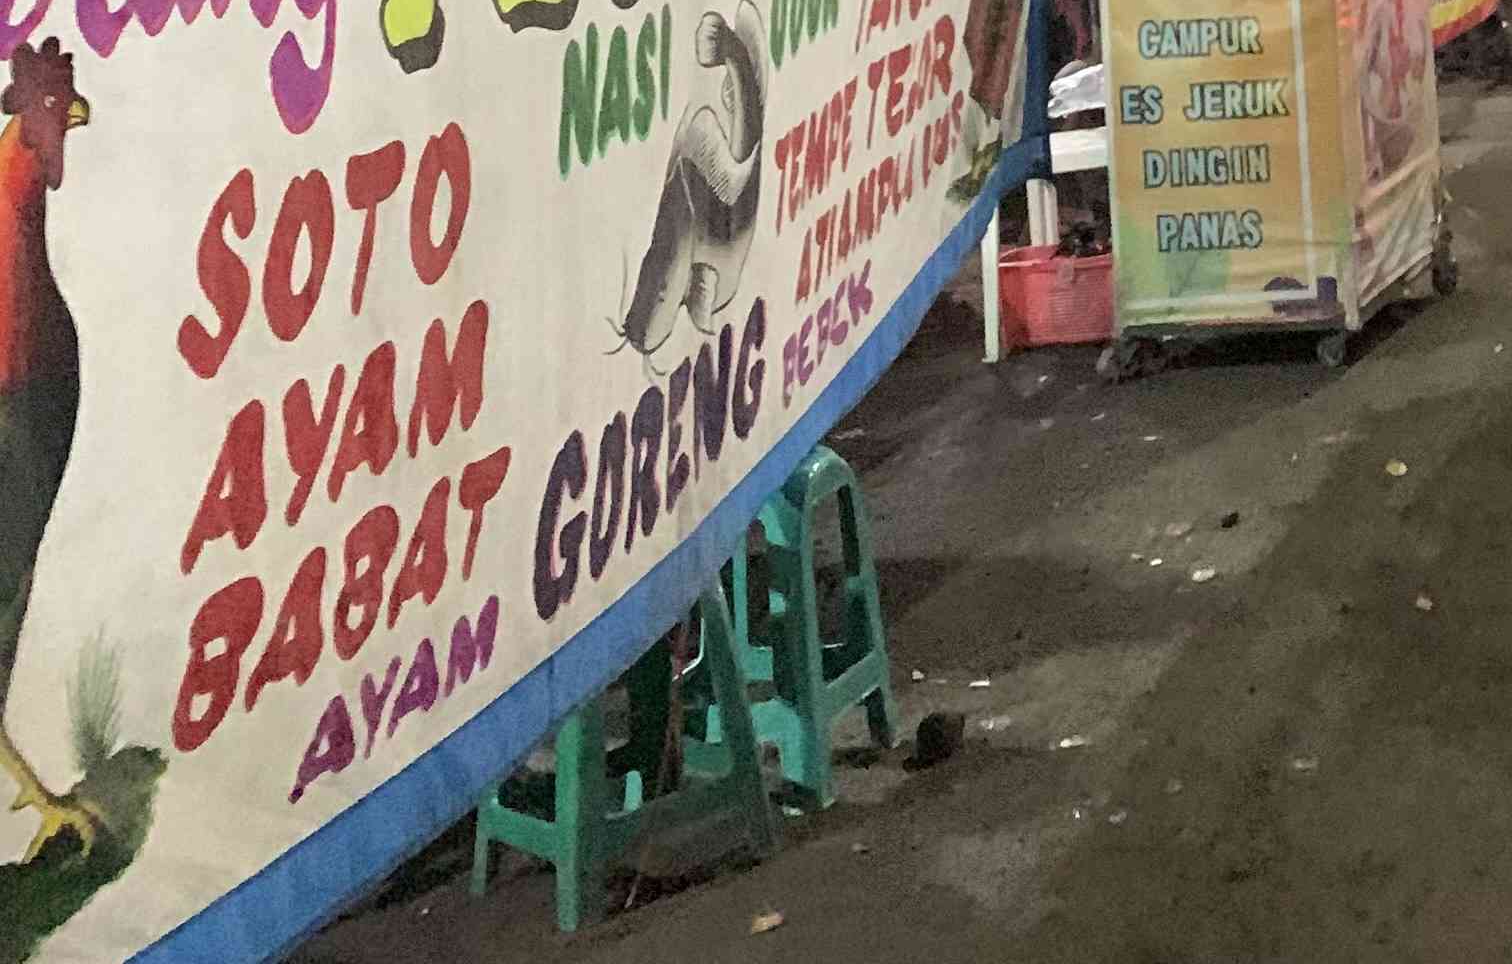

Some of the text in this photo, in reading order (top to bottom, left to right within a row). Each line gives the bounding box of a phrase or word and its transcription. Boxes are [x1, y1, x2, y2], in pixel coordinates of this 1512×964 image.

[557, 3, 672, 181] NASI
[1120, 78, 1290, 124] ES JERUK
[1138, 17, 1264, 59] CAMPUR
[775, 75, 858, 236] TEMPE
[1143, 144, 1271, 189] DINGIN
[1157, 210, 1263, 252] PANAS
[177, 122, 471, 378] SOTO
[180, 300, 488, 575] AYAM
[172, 447, 511, 752] BABAT
[288, 297, 766, 803] AYAM GORENG
